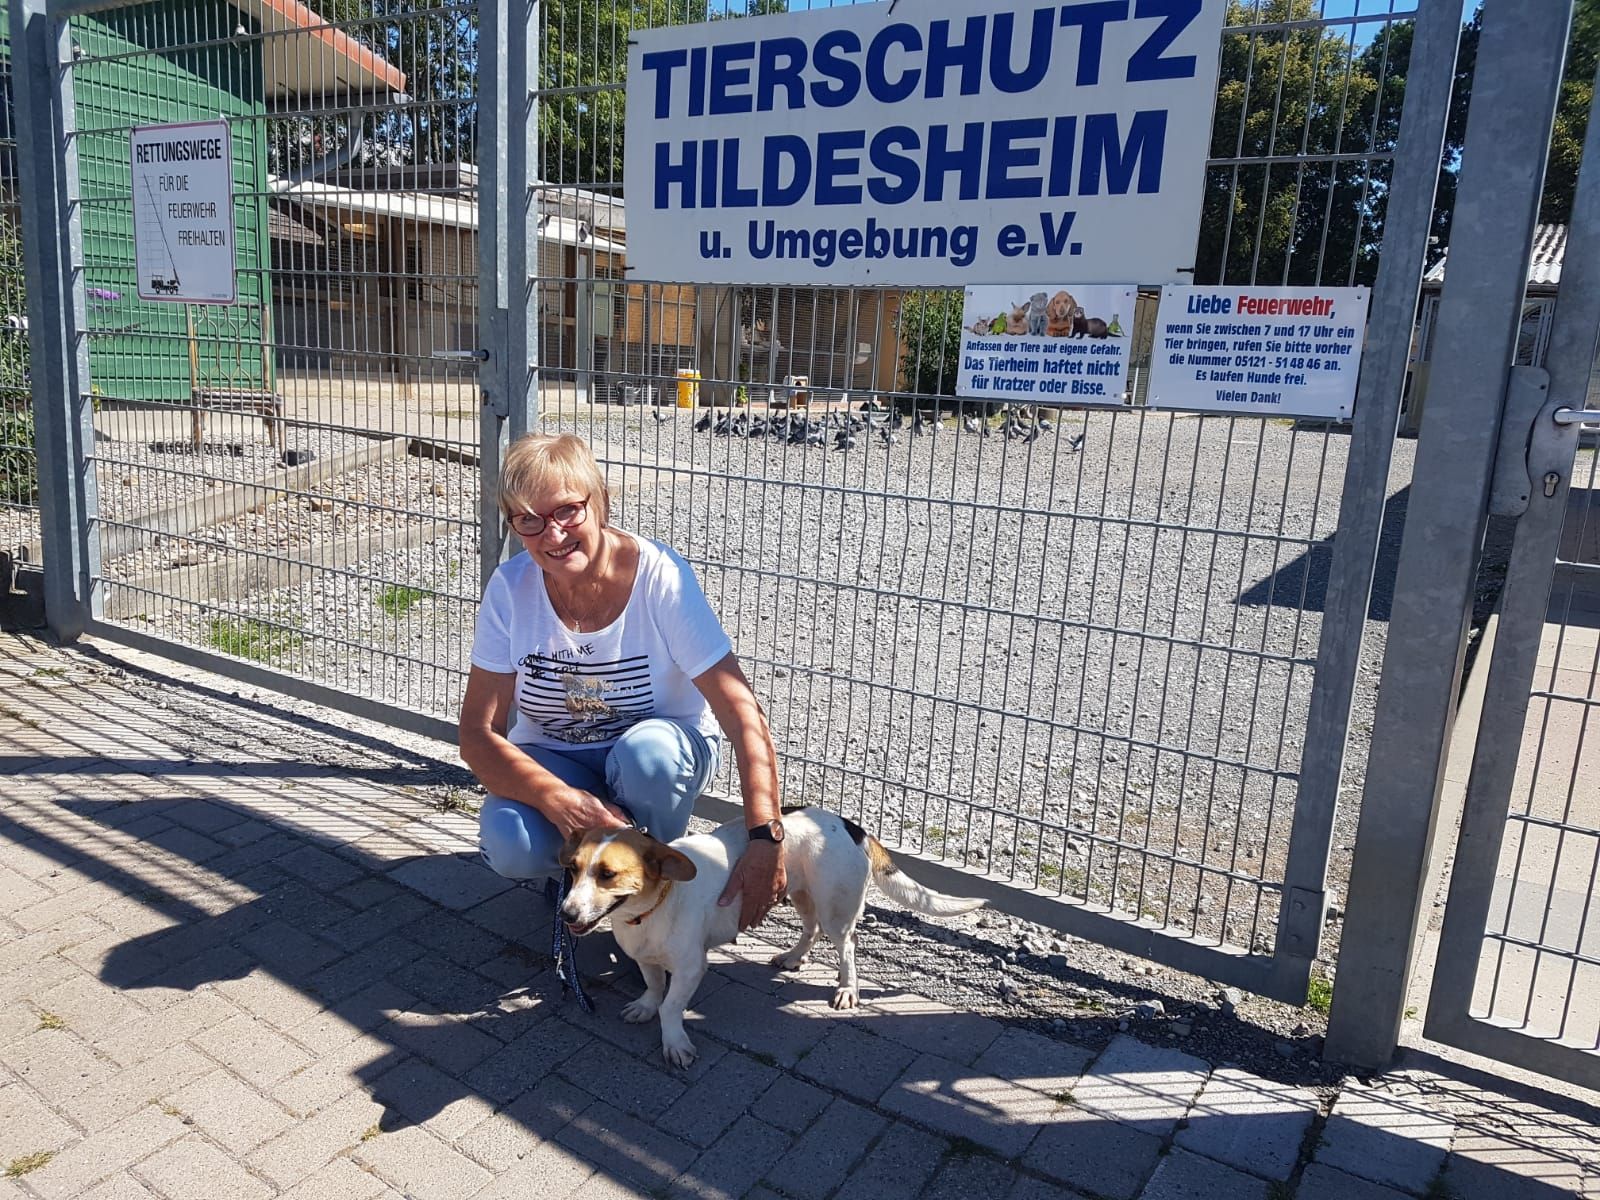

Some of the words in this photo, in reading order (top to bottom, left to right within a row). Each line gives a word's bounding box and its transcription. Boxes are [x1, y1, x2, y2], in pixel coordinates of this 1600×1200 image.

[642, 0, 1201, 119] TIERSCHUTZ
[137, 138, 222, 163] RETTUNGSWEGE
[654, 109, 1168, 209] HILDESHEIM
[159, 173, 174, 192] FÜR
[176, 175, 189, 191] DIE
[168, 202, 217, 219] FEUERWEHR
[178, 230, 225, 246] FREIHALTEN
[700, 231, 732, 259] u.
[748, 218, 978, 267] Umgebung
[997, 211, 1083, 257] e.V.
[1187, 295, 1232, 314] Liebe
[1237, 295, 1336, 319] Feuerwehr,
[1166, 323, 1193, 335] wenn
[1196, 323, 1211, 335] Sie
[1214, 324, 1261, 336] zwischen
[1264, 325, 1271, 336] 7
[1274, 325, 1294, 337] und
[1298, 325, 1310, 337] 17
[1313, 325, 1334, 338] Uhr
[1337, 327, 1355, 338] ein
[966, 340, 1002, 351] Anfassen
[1004, 341, 1018, 353] der
[1020, 342, 1040, 353] Tiere
[1043, 343, 1058, 354] auf
[1059, 344, 1088, 356] eigene
[1090, 344, 1122, 355] Gefahr.
[1165, 337, 1184, 350] Tier
[1186, 338, 1229, 353] bringen,
[1233, 340, 1262, 352] rufen
[1265, 340, 1281, 353] Sie
[1285, 341, 1311, 354] bitte
[1315, 342, 1352, 355] vorher
[964, 356, 984, 370] Das
[988, 357, 1039, 373] Tierheim
[1043, 359, 1082, 375] haftet
[1086, 360, 1121, 376] nicht
[1169, 353, 1184, 365] die
[1187, 354, 1232, 367] Nummer
[1235, 355, 1266, 368] 05121
[1324, 360, 1341, 371] an.
[971, 375, 989, 390] für
[993, 376, 1036, 392] Kratzer
[1039, 378, 1068, 394] oder
[1071, 379, 1106, 396] Bisse.
[1195, 370, 1207, 381] Es
[1210, 370, 1244, 382] laufen
[1247, 371, 1281, 384] Hunde
[1284, 373, 1307, 386] frei.
[1216, 389, 1247, 402] Vielen
[1250, 391, 1281, 404] Dank!
[576, 642, 596, 657] ME
